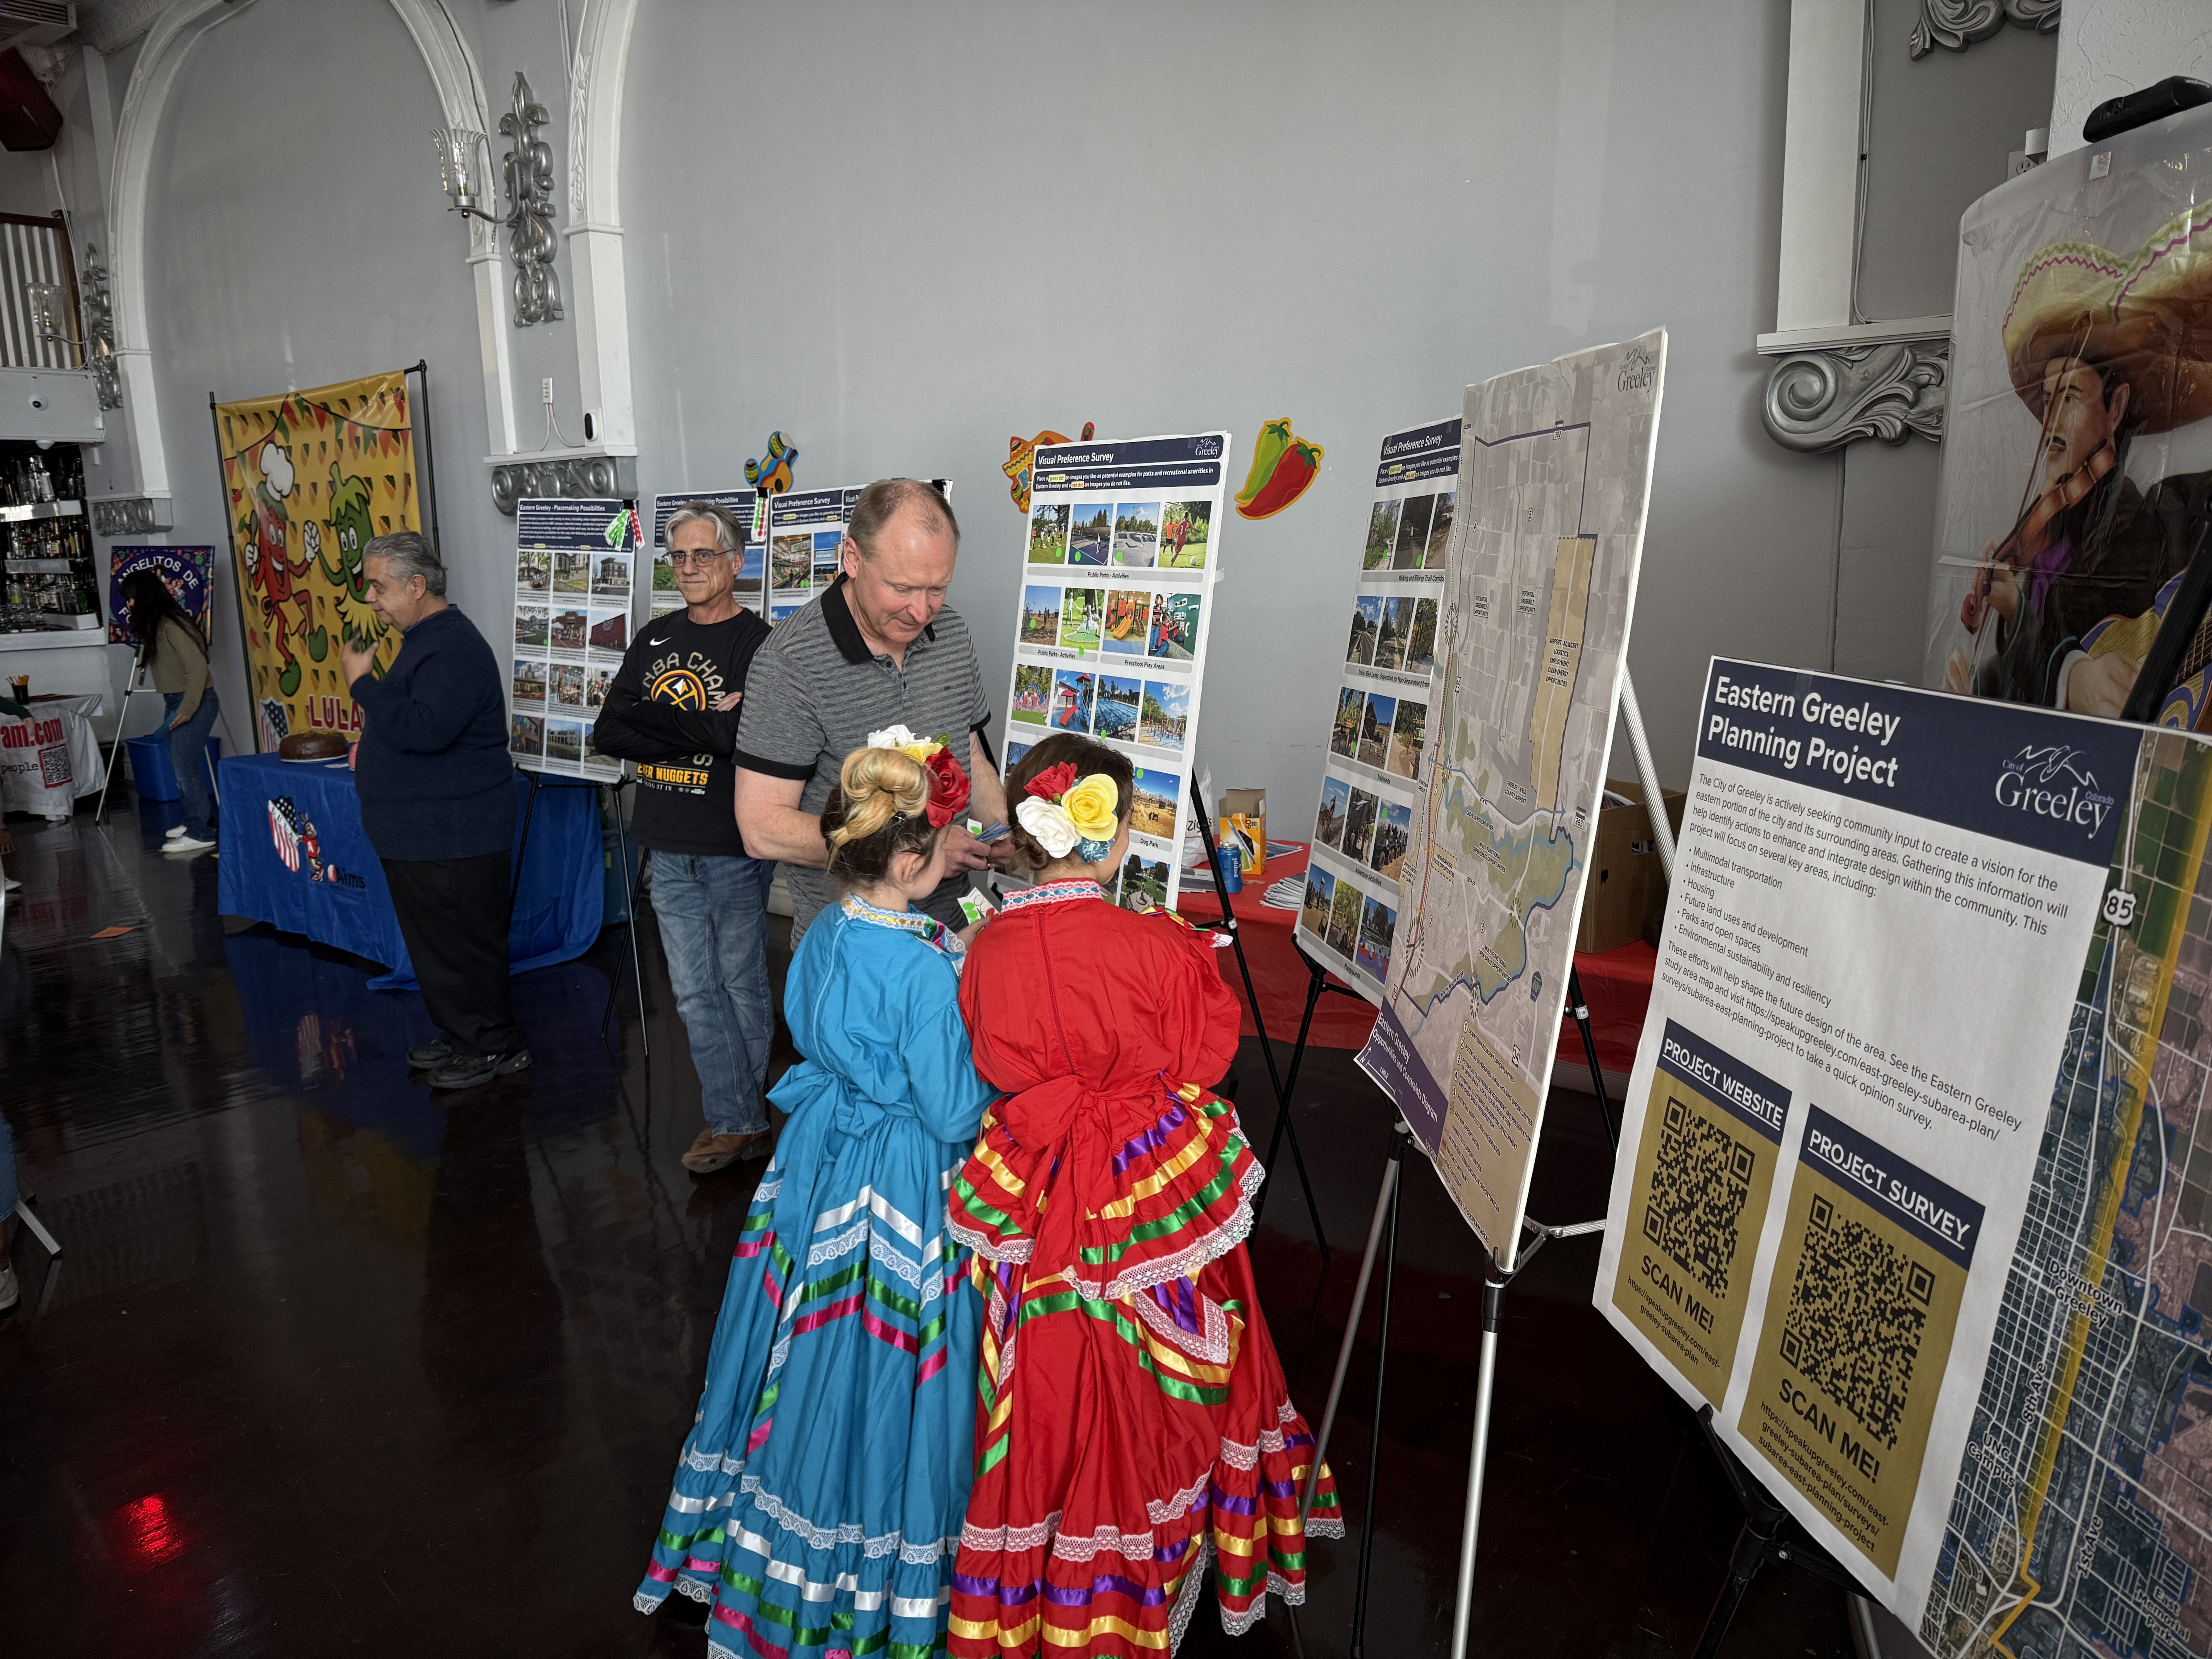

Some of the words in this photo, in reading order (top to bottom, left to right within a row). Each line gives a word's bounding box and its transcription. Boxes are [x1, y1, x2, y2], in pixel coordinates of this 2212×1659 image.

[1618, 367, 1655, 393] Greeley
[1038, 455, 1056, 465] Visual
[1057, 453, 1090, 464] Preference
[1091, 452, 1114, 463] Survey
[1195, 446, 1219, 457] Greeley
[1384, 443, 1398, 455] Visual
[1398, 439, 1425, 452] Preference
[1425, 435, 1443, 446] Survey
[788, 499, 813, 507] Preference
[183, 570, 199, 590] DE
[642, 652, 680, 689] NBA
[309, 696, 365, 732] LULA
[1715, 676, 1795, 718] Eastern
[1802, 692, 1901, 746] Greeley
[0, 762, 39, 775] people
[1708, 715, 1801, 769] Planning
[1806, 737, 1898, 787] Project
[656, 767, 709, 785] NUGGETS
[1377, 774, 1391, 785] Trailheads
[1996, 772, 2112, 839] Greeley
[2085, 791, 2114, 805] Colorado
[1140, 838, 1148, 846] Dog
[1245, 820, 1252, 829] 60
[1699, 773, 1712, 787] The
[1712, 777, 1727, 793] City
[1727, 783, 1736, 793] of
[1736, 784, 1766, 805] Greeley
[1766, 793, 1774, 805] is
[1774, 798, 1806, 817] actively
[1806, 807, 1842, 828] seeking
[1843, 818, 1894, 843] community
[1894, 830, 1920, 850] input
[1921, 839, 1932, 853] to
[1934, 846, 1969, 864] create
[1970, 857, 1978, 868] a
[1981, 858, 2014, 879] vision
[2017, 867, 2035, 884] for
[2037, 874, 2058, 891] the
[336, 866, 366, 889] Aims
[1355, 867, 1369, 879] Adventure
[1368, 873, 1382, 886] Activities
[1687, 876, 1715, 900] Housing
[1690, 861, 1735, 888] Infrastructure
[1693, 845, 1731, 869] Multimodal
[1731, 860, 1782, 890] transportation
[1684, 892, 1705, 910] Future
[1706, 902, 1723, 918] land
[1723, 911, 1741, 926] uses
[1741, 920, 1757, 933] and
[1757, 926, 1808, 957] development
[2107, 895, 2133, 919] 85
[1681, 908, 1700, 925] Parks
[1700, 919, 1714, 932] and
[1714, 926, 1734, 941] open
[1734, 934, 1761, 953] spaces
[1678, 923, 1726, 955] Environmental
[1726, 949, 1775, 980] sustainability
[1775, 972, 1791, 987] and
[1791, 980, 1832, 1008] resiliency
[1378, 1011, 1394, 1040] Eastern
[1394, 1032, 1411, 1065] Greeley
[1513, 1049, 1519, 1062] 34
[1372, 1028, 1397, 1063] Opportunities
[1402, 1068, 1422, 1100] Constraints
[1422, 1094, 1438, 1123] Diagram
[1664, 1038, 1721, 1085] PROJECT
[1723, 1073, 1783, 1127] WEBSITE
[1810, 1129, 1887, 1190] PROJECT
[1888, 1180, 1971, 1242] SURVEY
[1641, 1255, 1683, 1306] SCAN
[1685, 1293, 1714, 1335] ME!
[2050, 1261, 2123, 1314] Downtown
[2055, 1286, 2107, 1328] Greeley
[1628, 1276, 1720, 1368] https://speakupgreeley.com/east-
[1640, 1305, 1698, 1365] greeley-subarea-plan
[2023, 1395, 2037, 1423] 8th
[2030, 1362, 2045, 1393] Ave
[1779, 1379, 1836, 1444] SCAN
[1840, 1431, 1880, 1484] ME!
[1983, 1432, 2010, 1461] UNC
[1760, 1401, 1889, 1526] https://speakupgreeley.com/east-
[1762, 1422, 1880, 1536] greeley-subarea-plan/surveys/
[1968, 1442, 2014, 1487] Campus
[1759, 1436, 1875, 1553] subarea-east-planning-project
[2078, 1548, 2092, 1577] 1st
[2085, 1516, 2101, 1548] Ave
[2136, 1591, 2190, 1642] Memorial
[2155, 1589, 2179, 1615] East
[2147, 1615, 2174, 1644] Park
